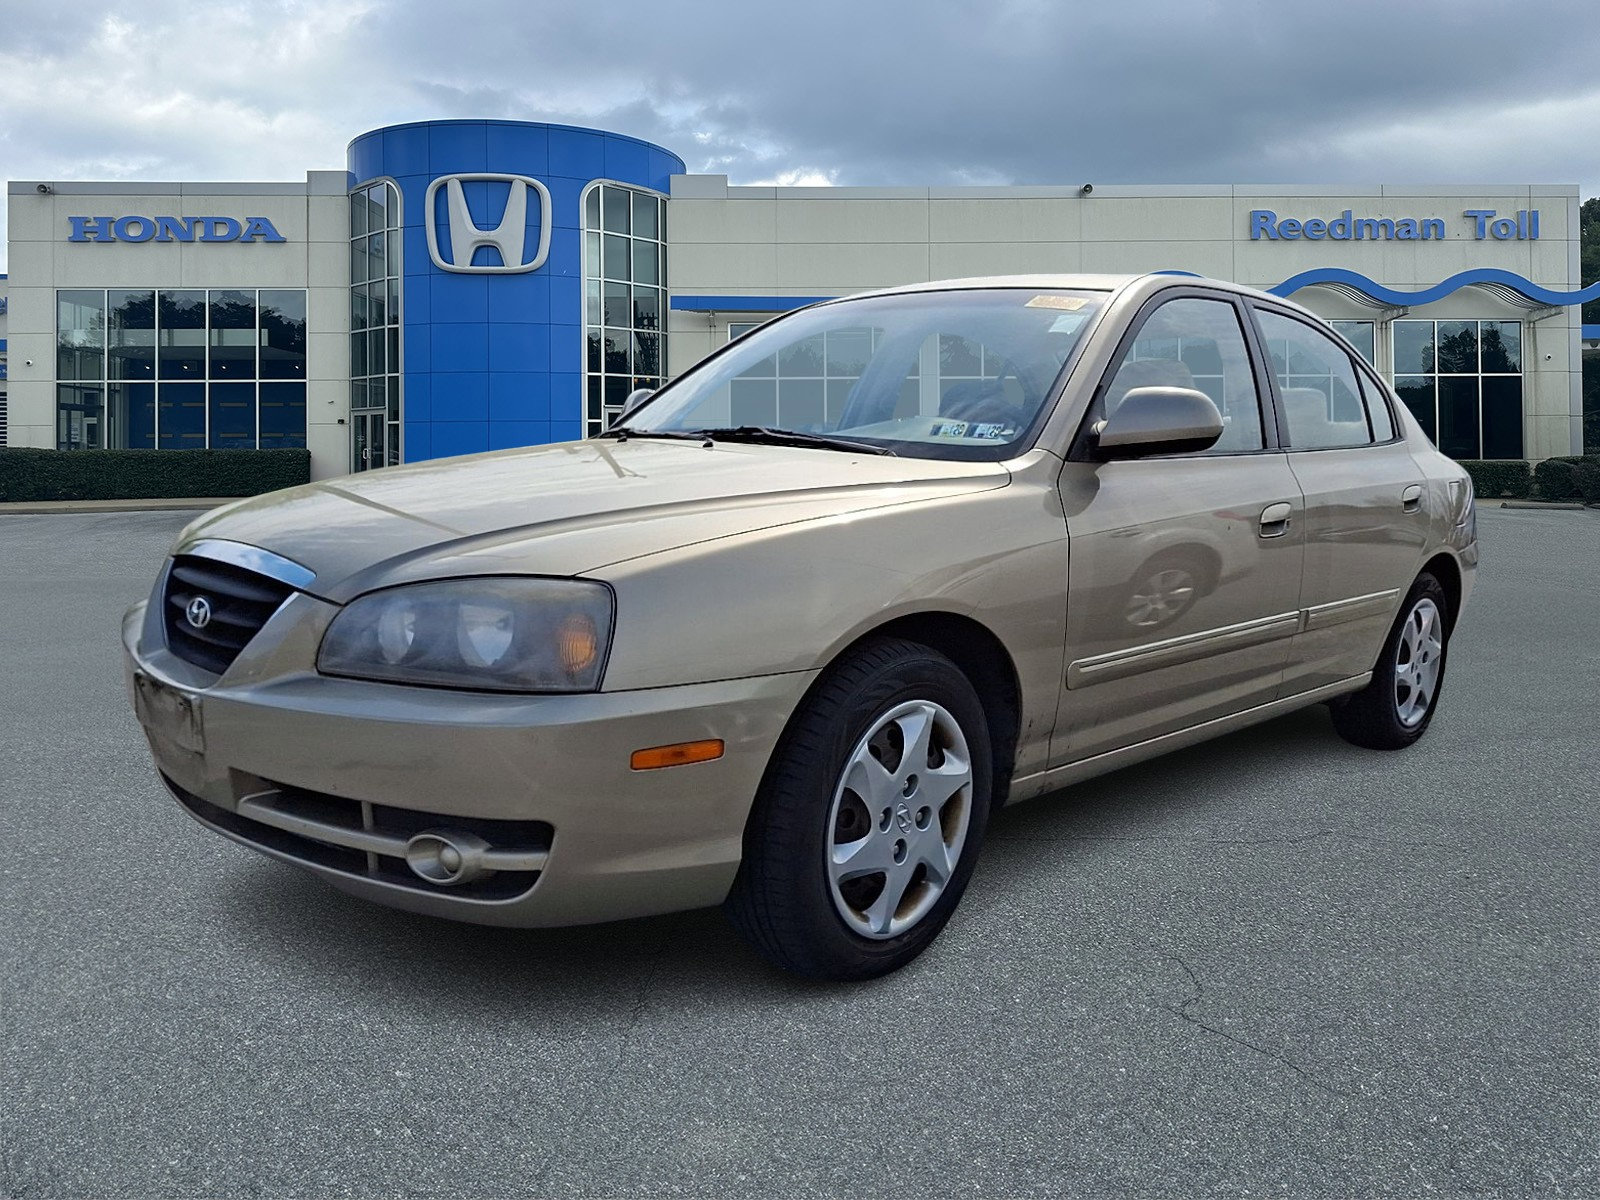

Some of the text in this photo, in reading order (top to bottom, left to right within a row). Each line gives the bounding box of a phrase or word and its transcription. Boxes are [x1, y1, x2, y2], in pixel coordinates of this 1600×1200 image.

[68, 215, 287, 243] HONDA
[1250, 210, 1539, 240] Reedman Toll
